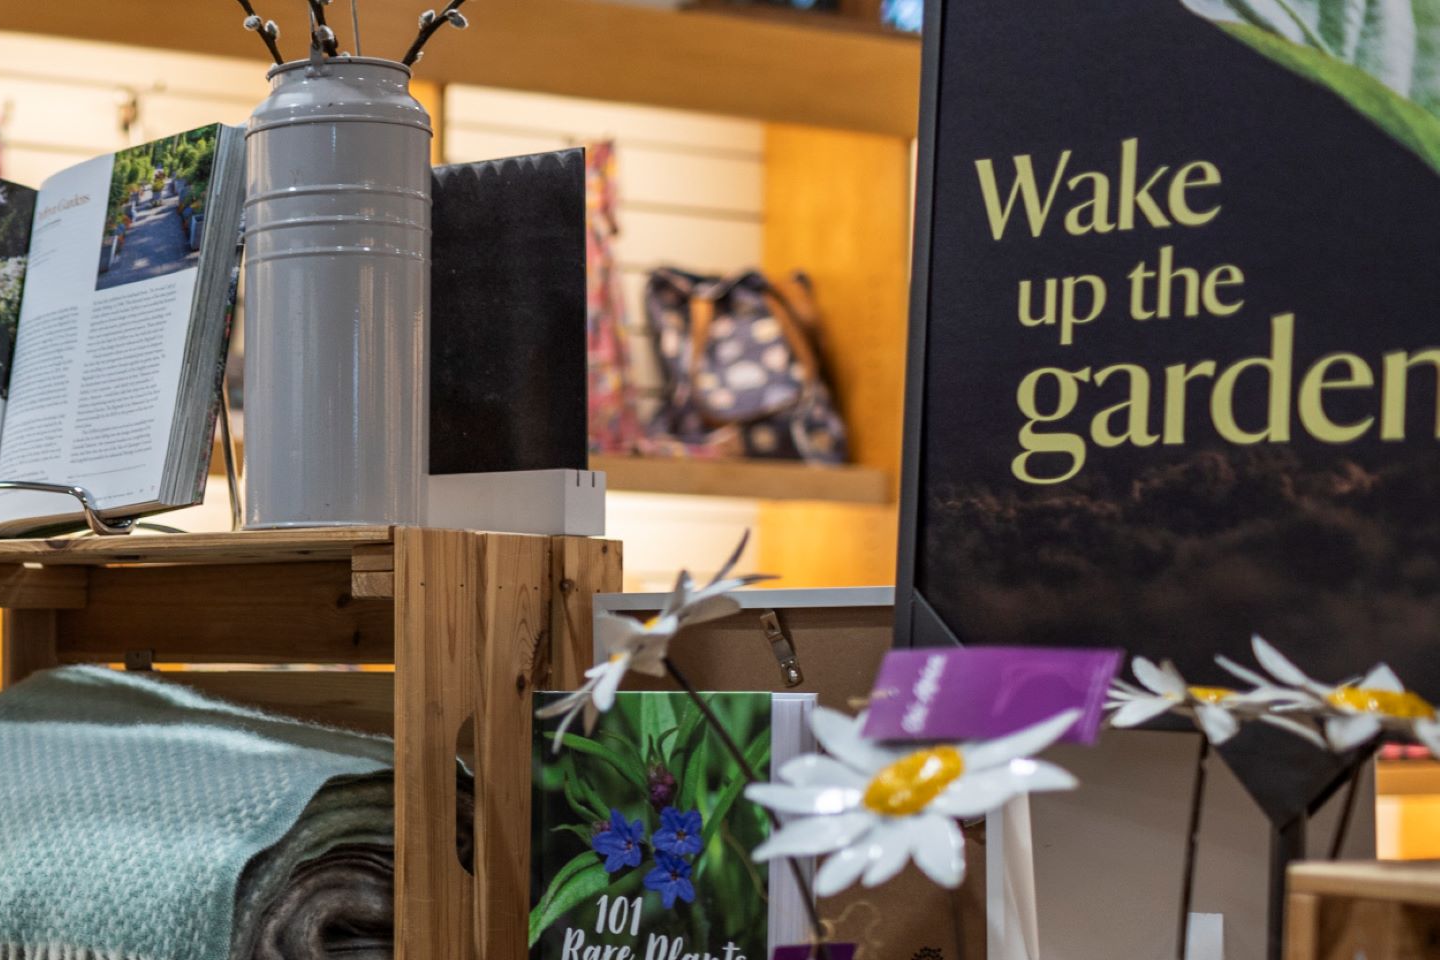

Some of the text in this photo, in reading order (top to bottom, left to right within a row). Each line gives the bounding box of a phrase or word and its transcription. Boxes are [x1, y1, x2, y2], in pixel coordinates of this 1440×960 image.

[974, 137, 1222, 241] Wake
[1017, 245, 1245, 346] up the
[1011, 312, 1440, 485] garden
[595, 894, 643, 937] 101
